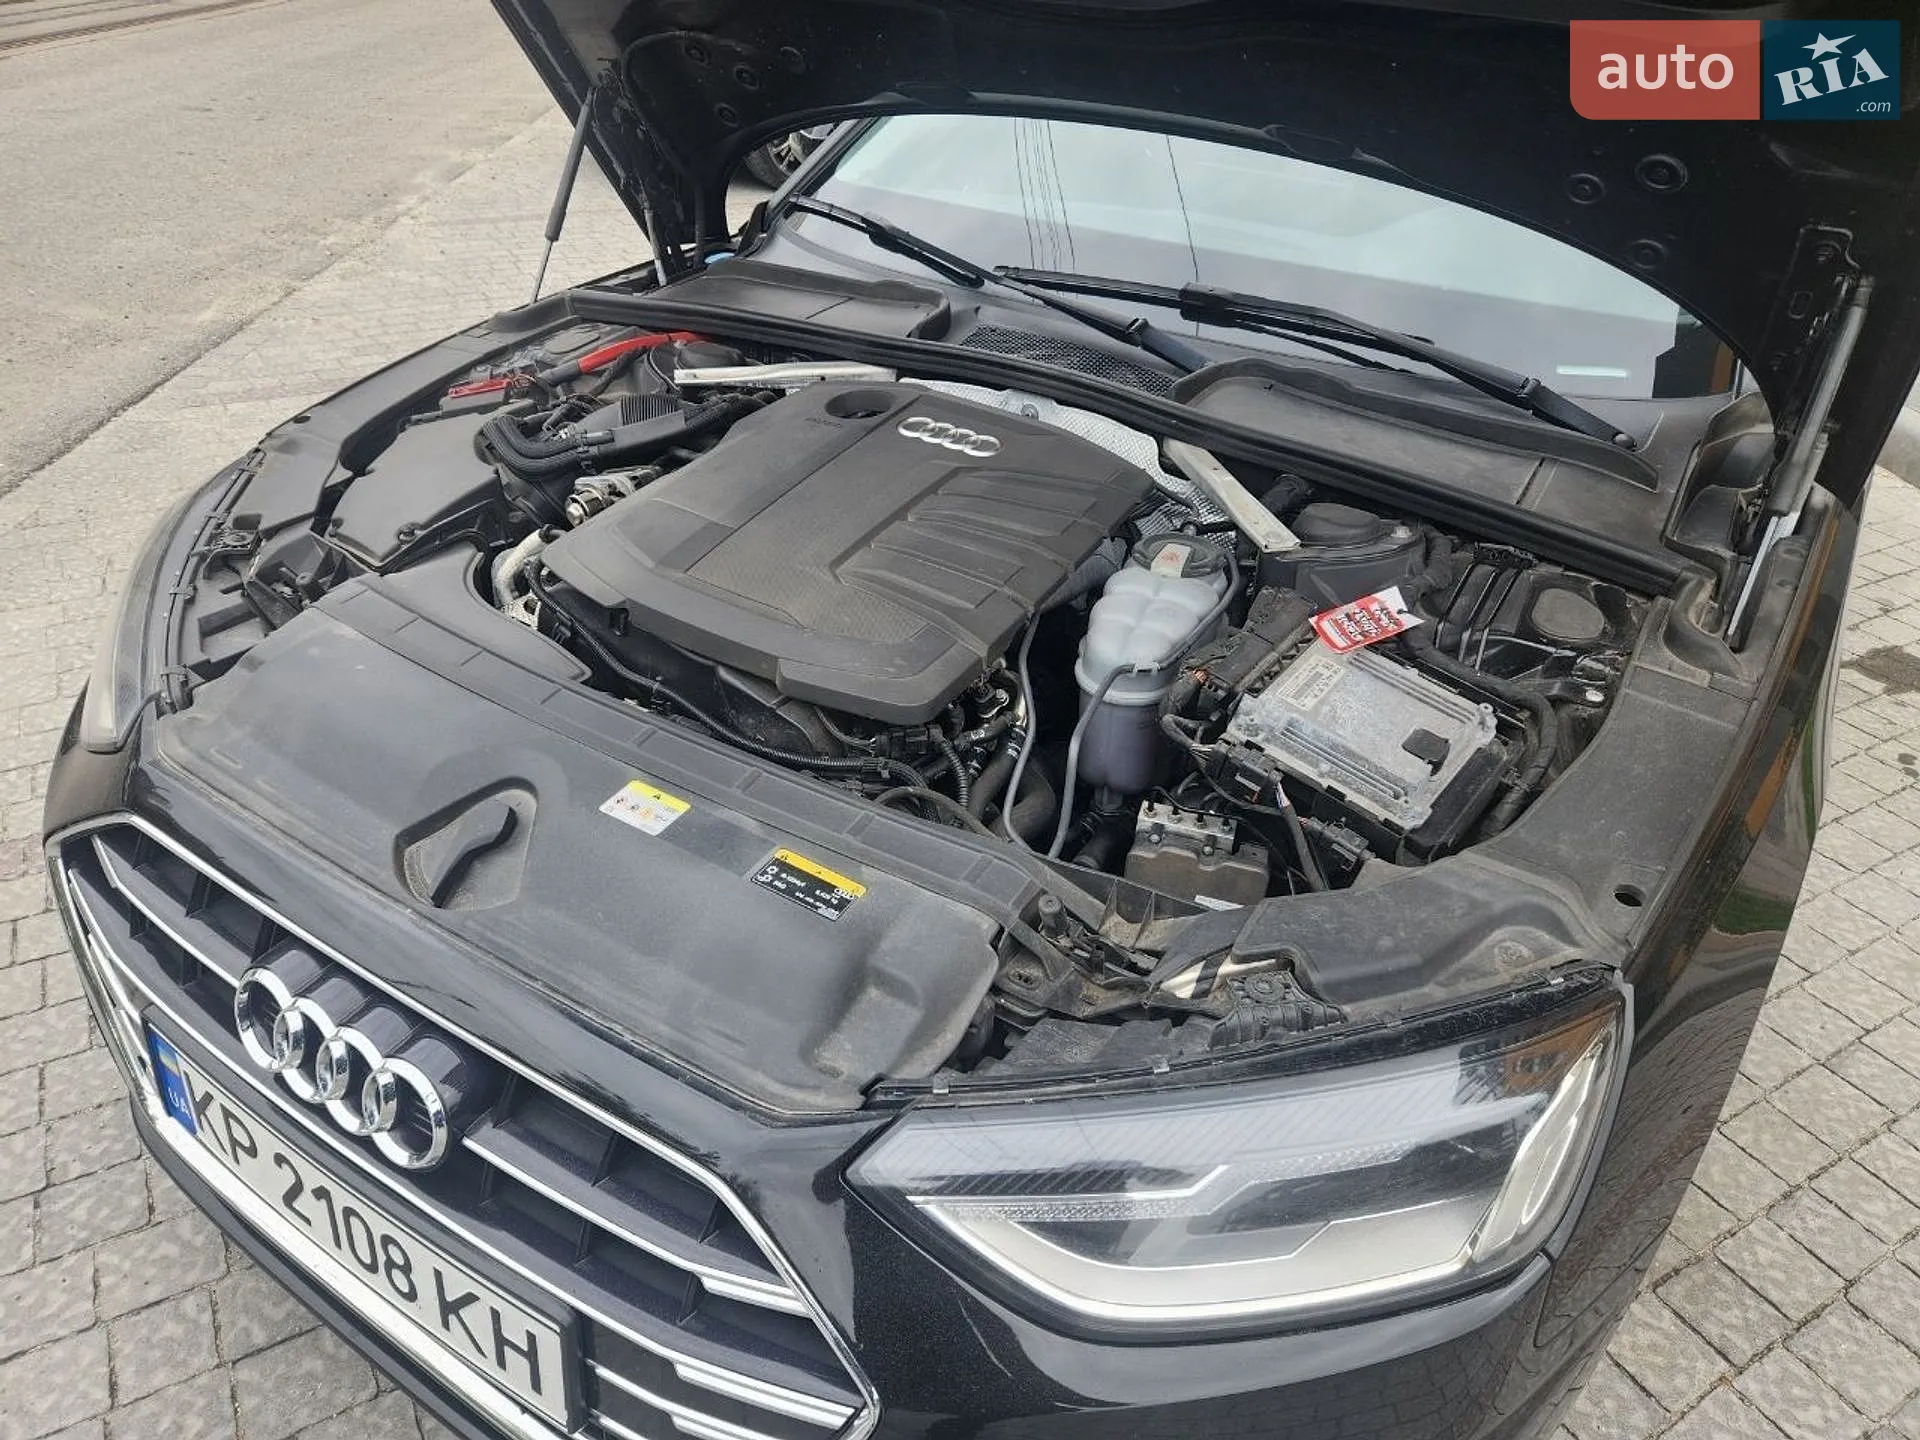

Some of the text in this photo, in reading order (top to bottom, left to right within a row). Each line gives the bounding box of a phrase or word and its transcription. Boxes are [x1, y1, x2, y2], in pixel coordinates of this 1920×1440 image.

[168, 1086, 192, 1120] UA
[182, 1070, 542, 1396] KP 2108 KH
